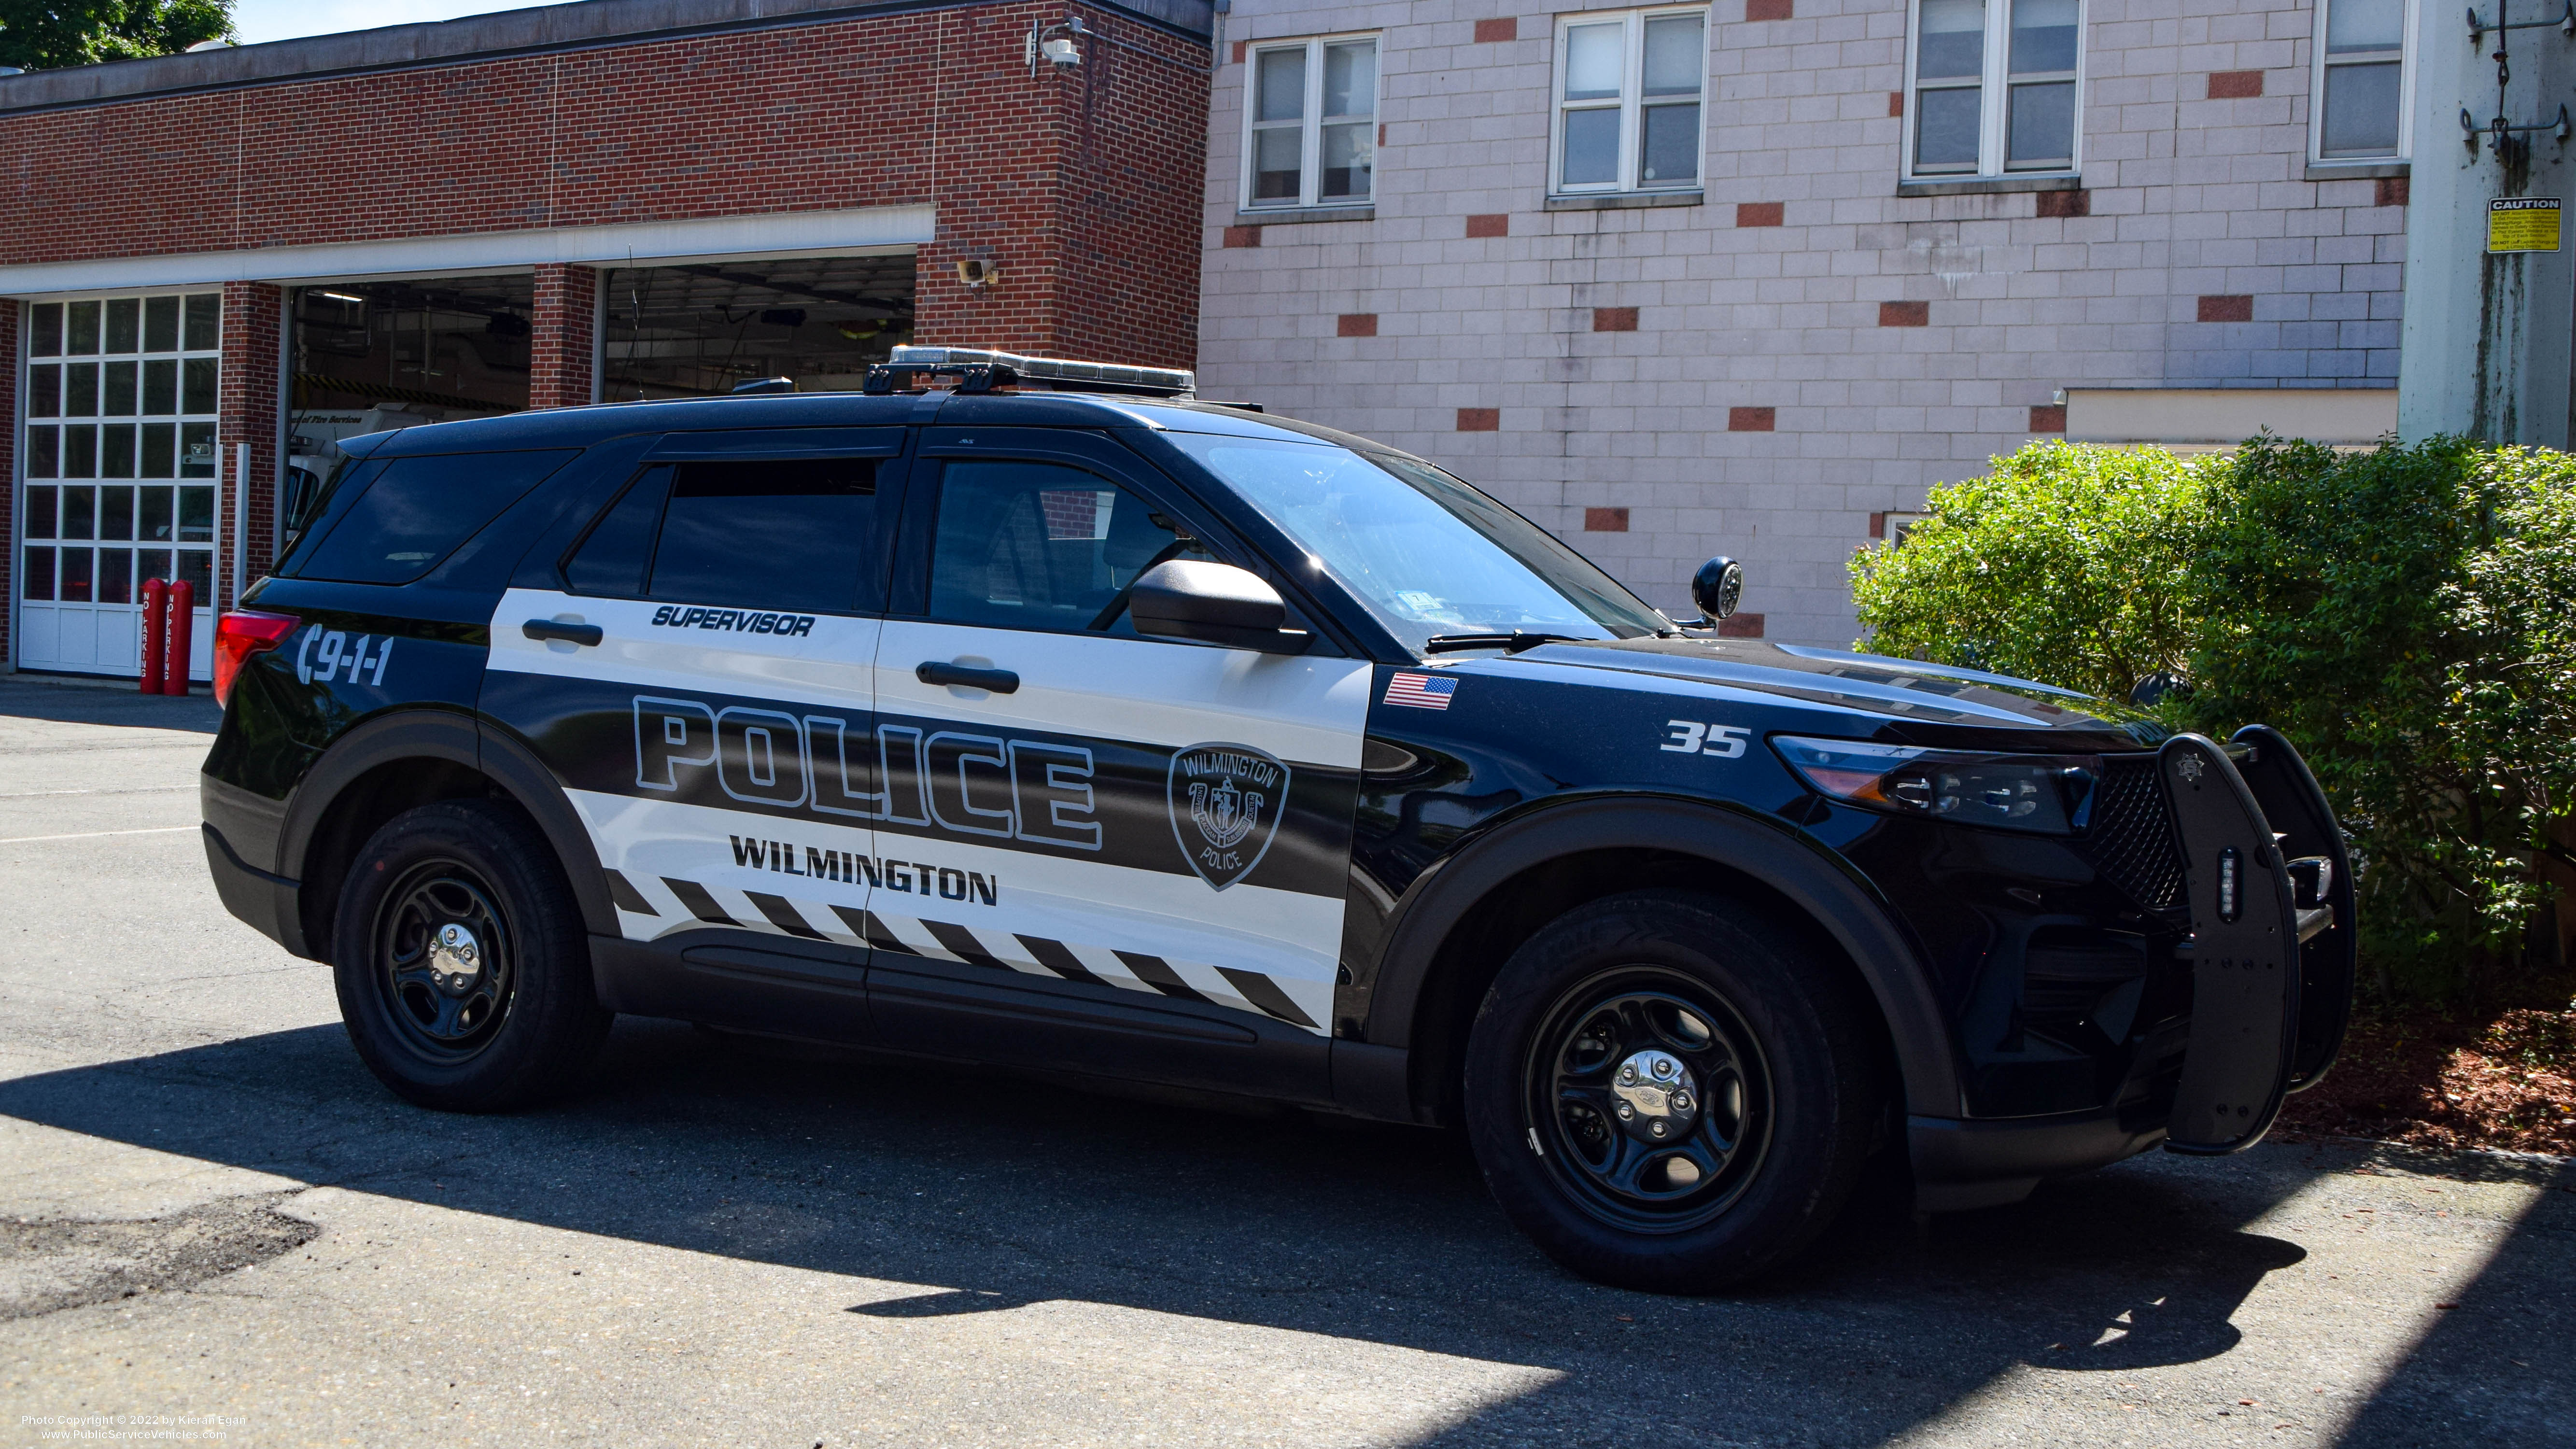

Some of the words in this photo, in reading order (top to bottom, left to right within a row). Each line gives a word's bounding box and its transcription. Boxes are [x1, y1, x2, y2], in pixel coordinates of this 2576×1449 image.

[2492, 200, 2559, 210] CAUTION
[144, 592, 149, 609] NO
[169, 594, 173, 612] NO
[651, 605, 816, 638] SUPERVISOR
[1660, 719, 1751, 758] 35
[633, 695, 1102, 852] POLICE
[1183, 753, 1279, 788] WILMINGTON
[729, 835, 997, 907] WILMINGTON
[1199, 846, 1243, 870] POLICE
